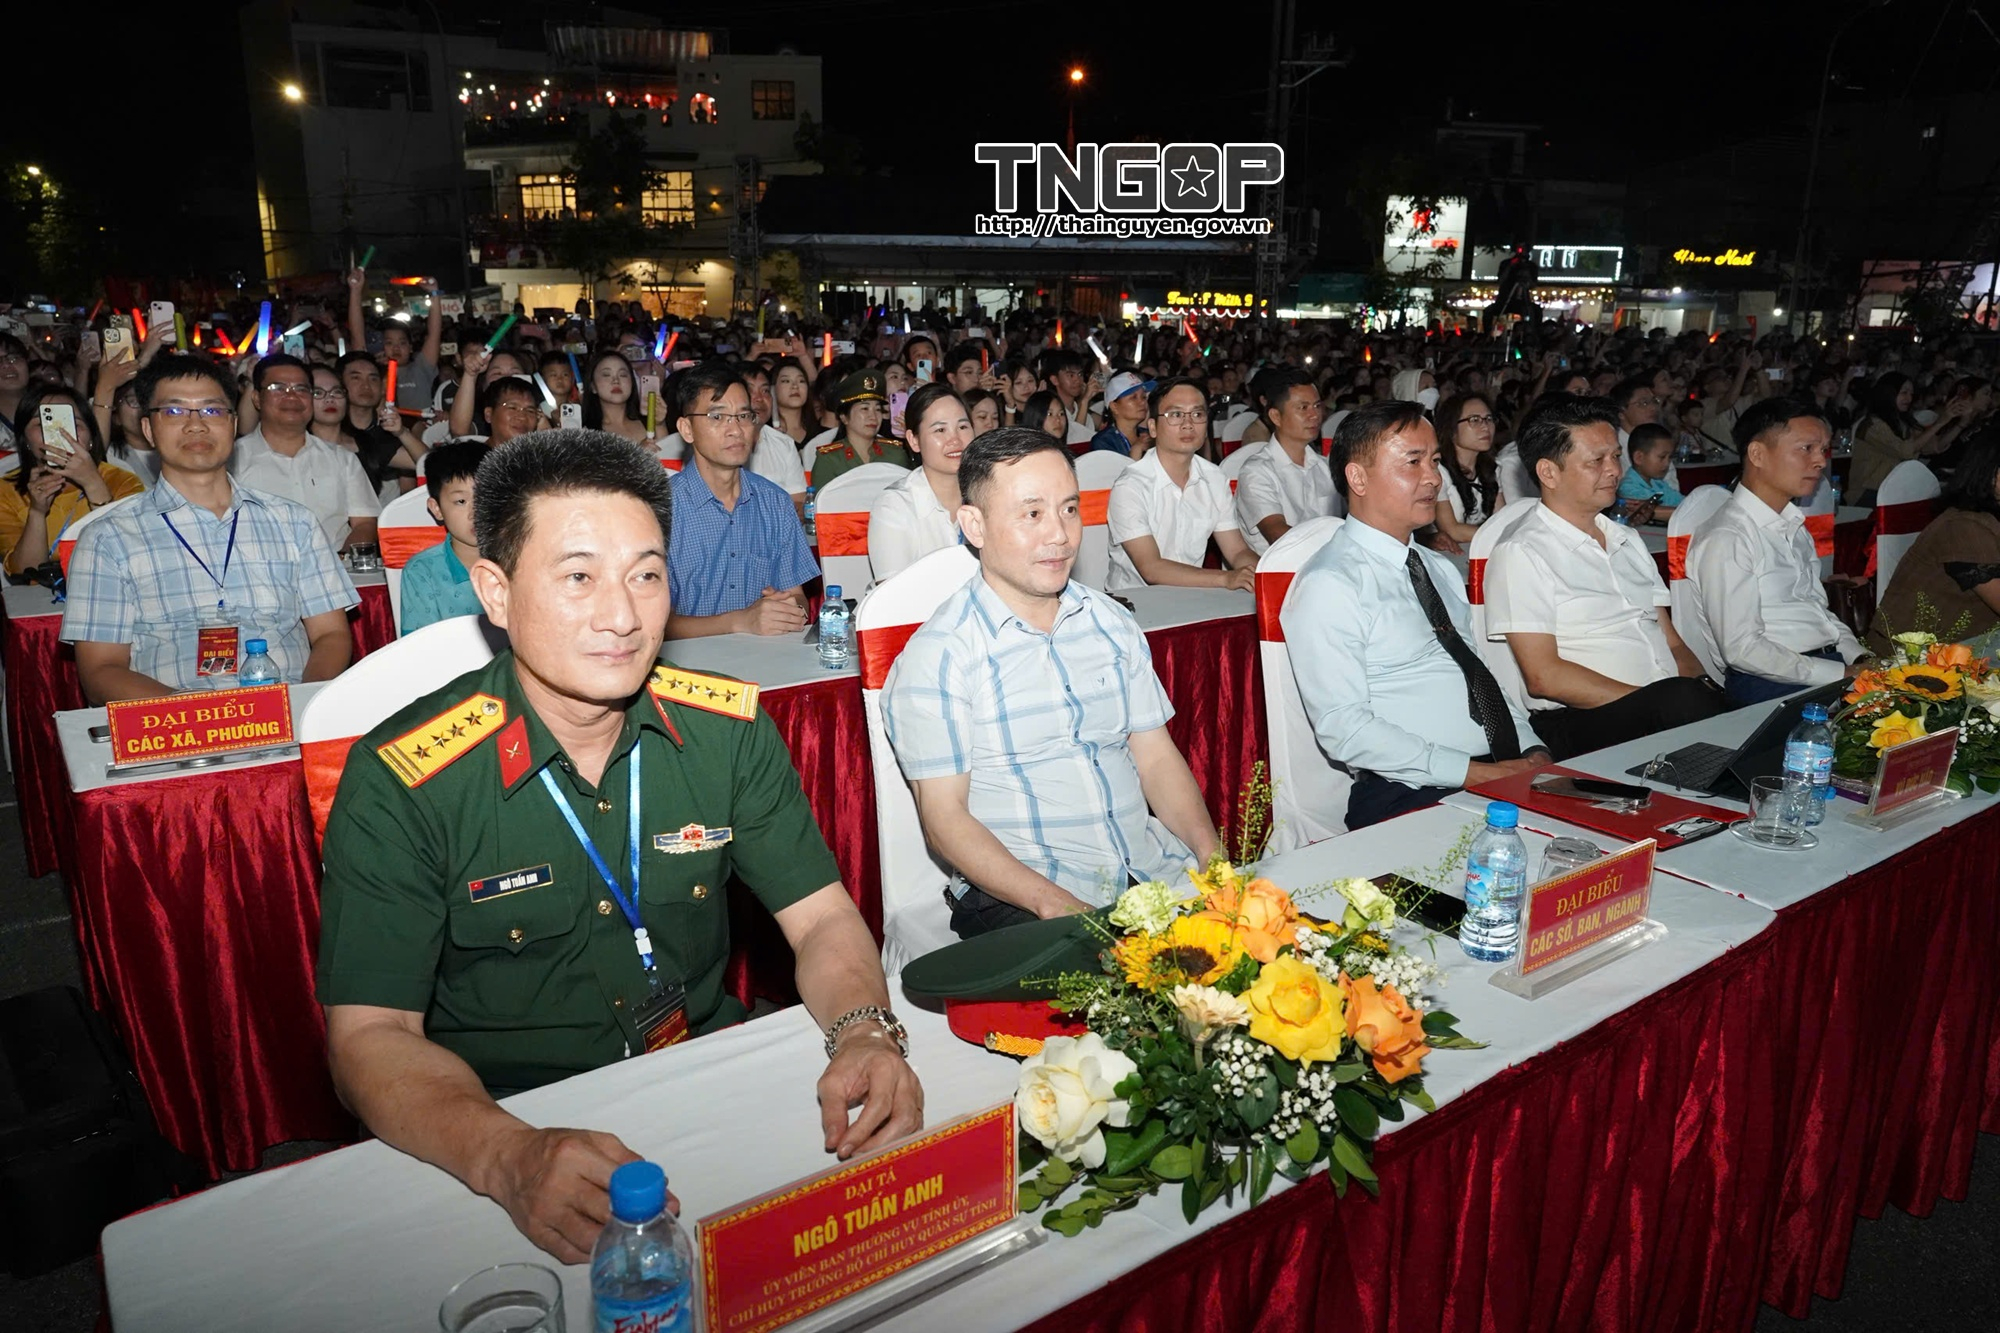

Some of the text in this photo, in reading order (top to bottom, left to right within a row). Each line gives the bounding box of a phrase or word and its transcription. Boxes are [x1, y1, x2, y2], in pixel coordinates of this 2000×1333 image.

[1714, 249, 1756, 266] Nail
[127, 721, 280, 754] CÁC XÃ, PHƯỜNG
[142, 698, 255, 729] ĐẠI BIỂU
[1556, 868, 1624, 916] ĐẠI BIỂU
[1530, 893, 1642, 957] CÁC SỞ, BAN, NGÀNH
[845, 1165, 897, 1200] ĐẠI TÁ
[793, 1174, 944, 1258] NGÔ TUẤN ANH
[757, 1293, 786, 1316] HUY
[788, 1270, 843, 1301] TRƯỞNG
[846, 1257, 864, 1275] BỘ
[891, 1235, 915, 1254] HUY
[918, 1219, 951, 1241] QUÂN
[952, 1208, 968, 1226] SỰ
[784, 1264, 817, 1285] VIÊN
[820, 1250, 846, 1271] BAN
[848, 1226, 900, 1258] THƯỜNG
[902, 1218, 919, 1233] VỤ
